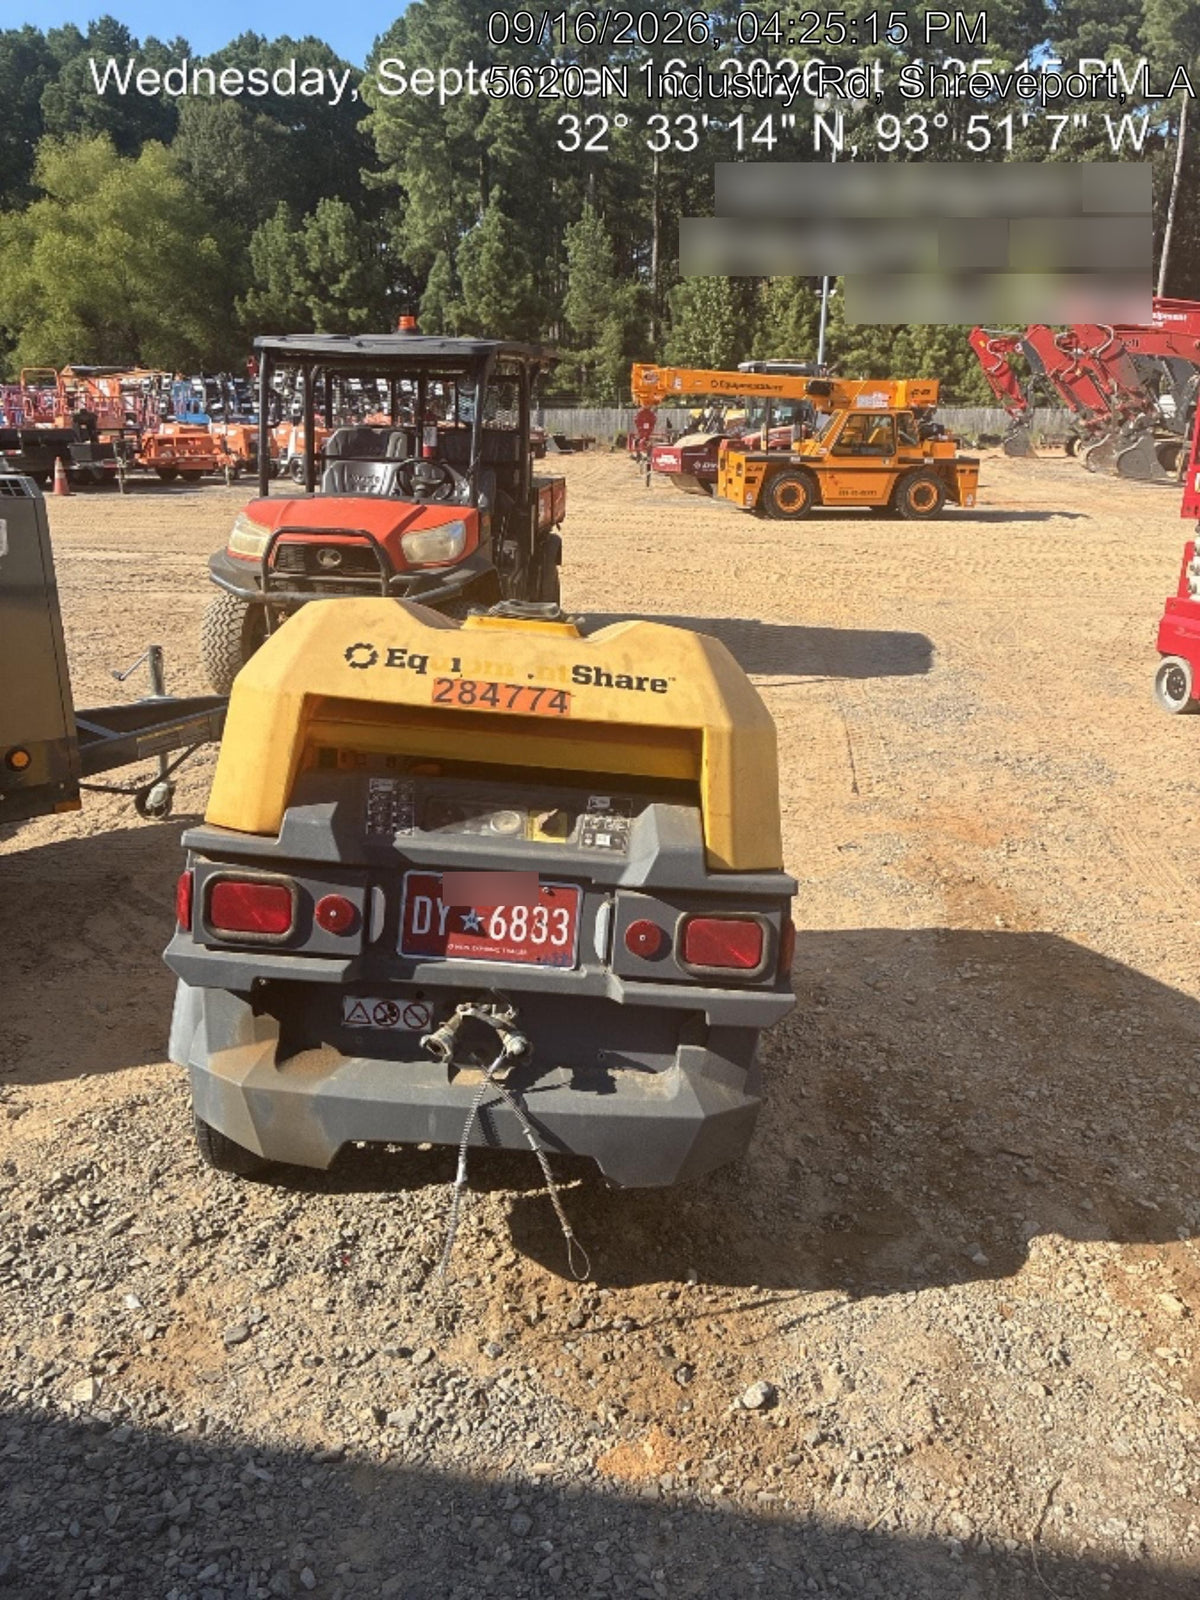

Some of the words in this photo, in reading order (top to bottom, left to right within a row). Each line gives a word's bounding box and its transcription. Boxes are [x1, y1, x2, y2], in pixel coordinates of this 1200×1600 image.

[433, 677, 570, 715] 284774
[411, 895, 450, 936] DY
[488, 904, 570, 946] 6833
